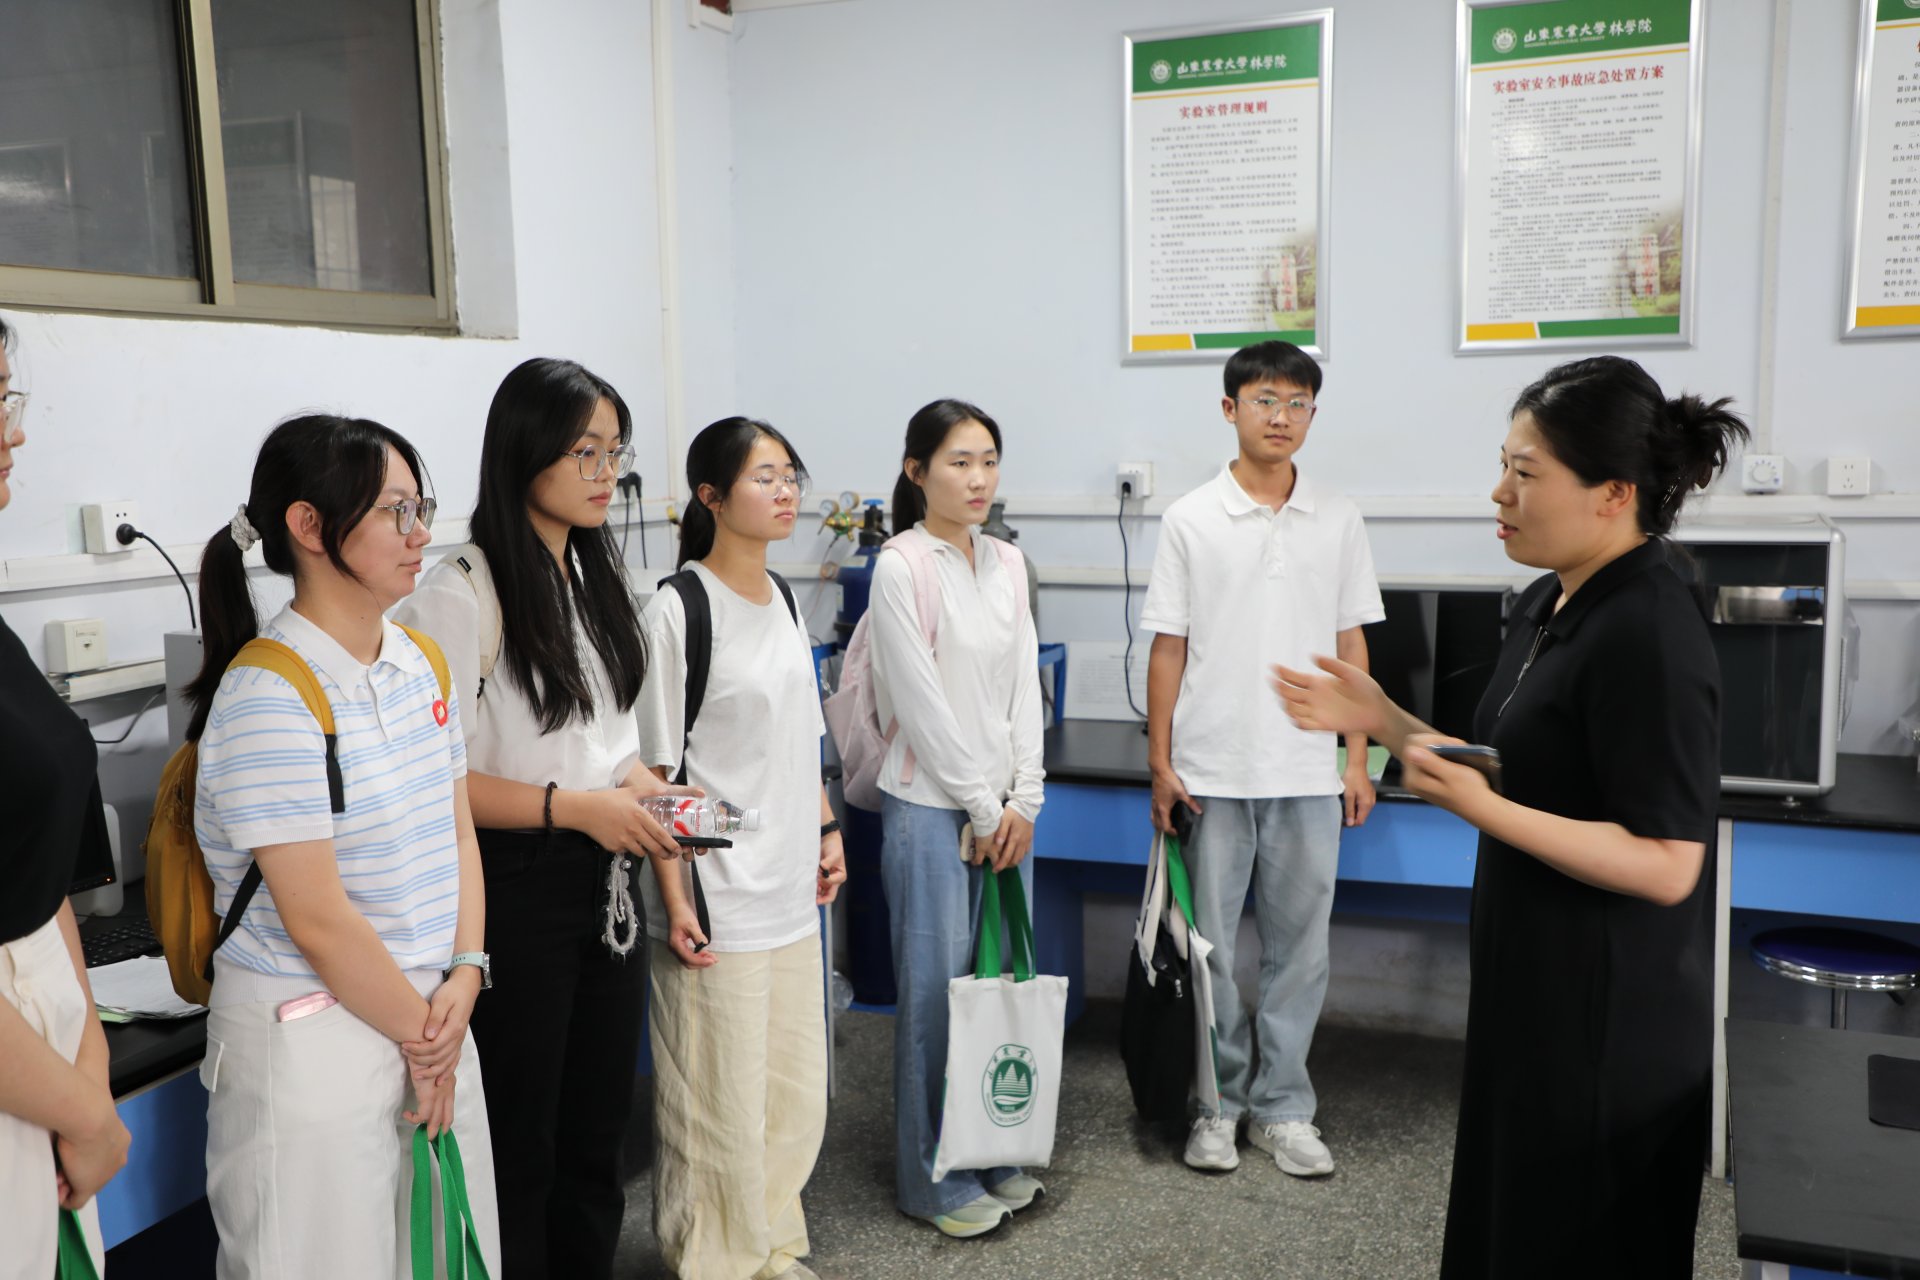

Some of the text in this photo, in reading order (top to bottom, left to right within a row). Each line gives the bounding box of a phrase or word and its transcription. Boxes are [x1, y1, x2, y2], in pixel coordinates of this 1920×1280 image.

[1493, 65, 1664, 94] 实验室安全事故应急处置方案
[1179, 100, 1267, 119] 实验室管理规则
